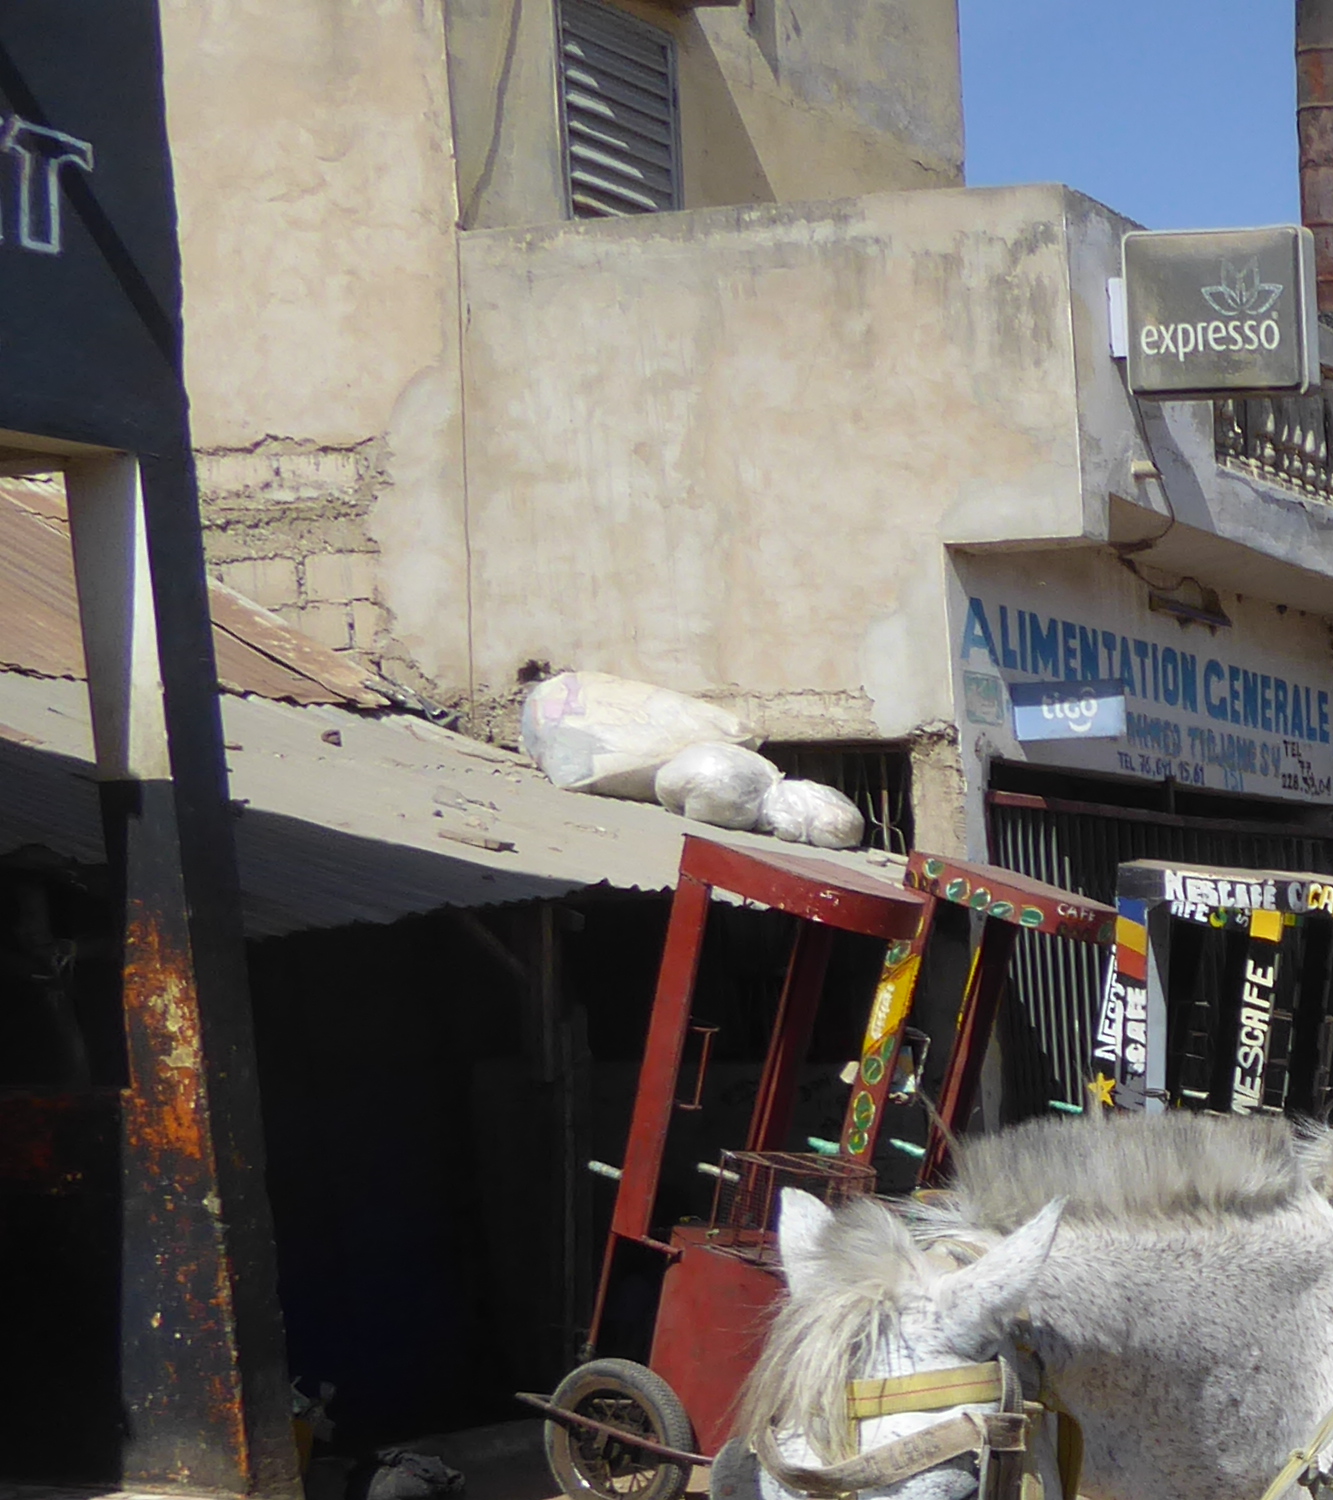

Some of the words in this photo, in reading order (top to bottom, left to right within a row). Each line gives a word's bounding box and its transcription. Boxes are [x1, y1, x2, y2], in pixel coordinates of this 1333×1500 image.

[1140, 318, 1281, 362] expresso
[960, 597, 1199, 714] ALIMENTATION
[1203, 659, 1330, 744] GENERALE
[1042, 687, 1098, 732] tigo
[1283, 740, 1302, 757] TEL
[1231, 959, 1273, 1115] NESCAFE
